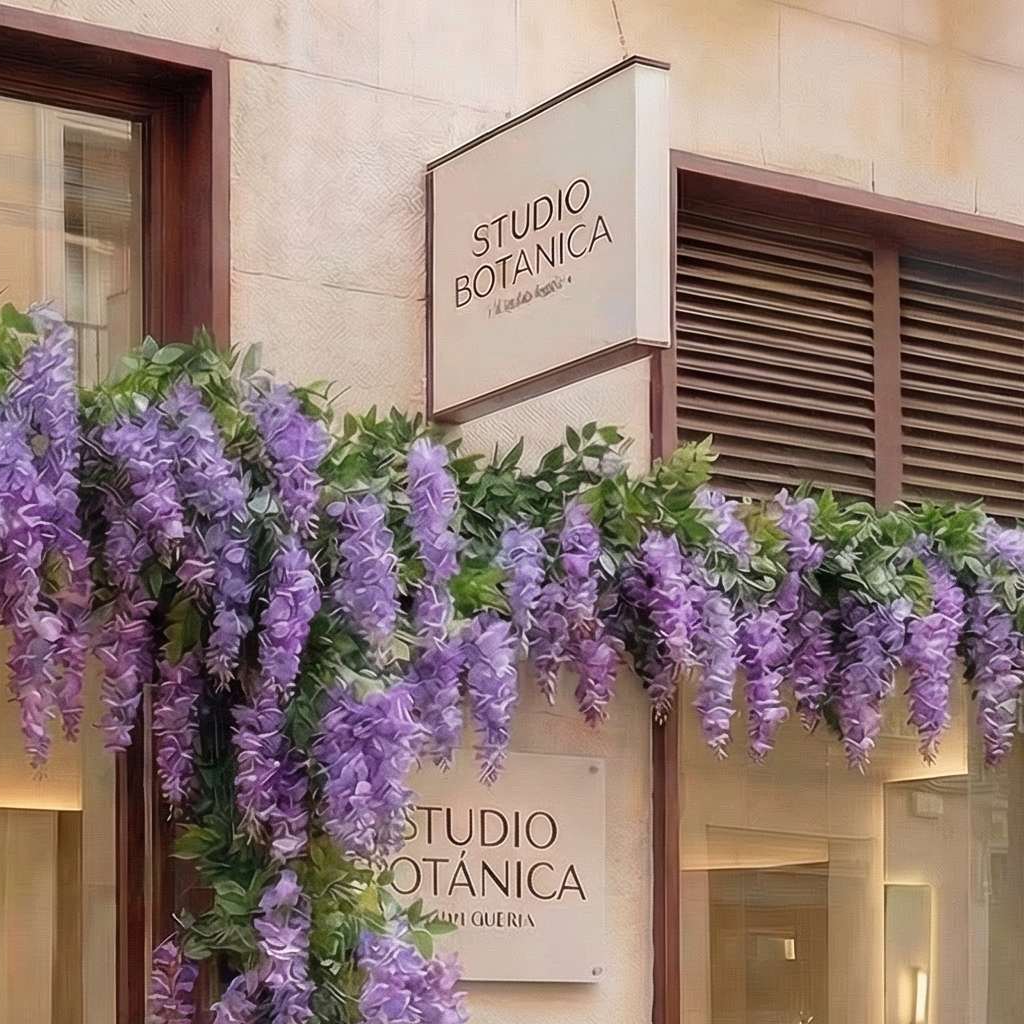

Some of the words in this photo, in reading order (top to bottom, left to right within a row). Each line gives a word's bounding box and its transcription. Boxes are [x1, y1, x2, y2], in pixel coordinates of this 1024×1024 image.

[472, 179, 590, 257] STUDIO
[456, 216, 612, 307] BOTANICA
[388, 850, 587, 900] OTÁNICA
